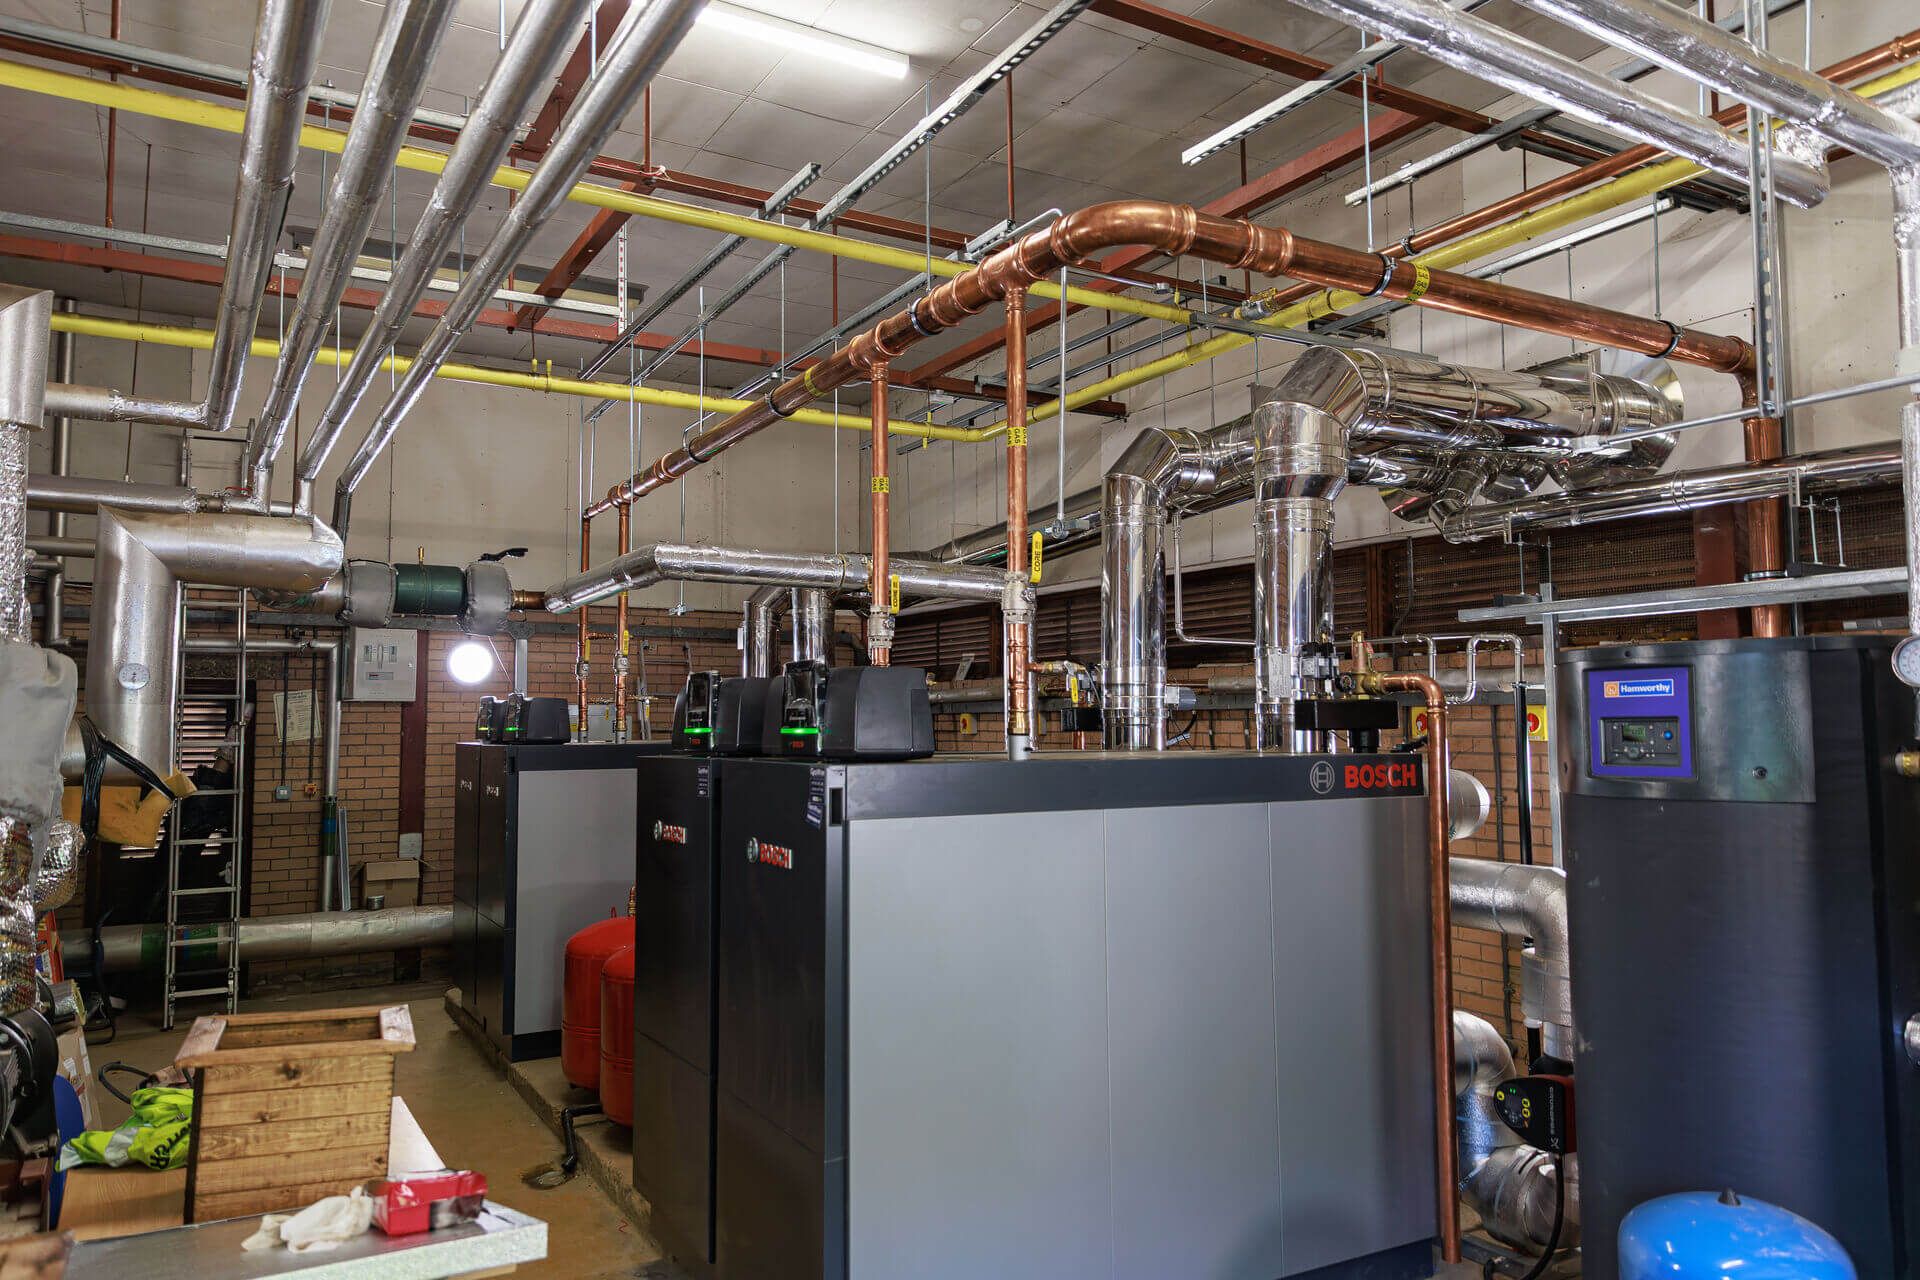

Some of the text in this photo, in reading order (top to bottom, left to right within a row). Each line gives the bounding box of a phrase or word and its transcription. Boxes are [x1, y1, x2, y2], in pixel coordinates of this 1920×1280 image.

[1620, 683, 1670, 693] Hamworthy
[1344, 763, 1417, 789] BOSCH
[760, 843, 792, 869] BOSCH
